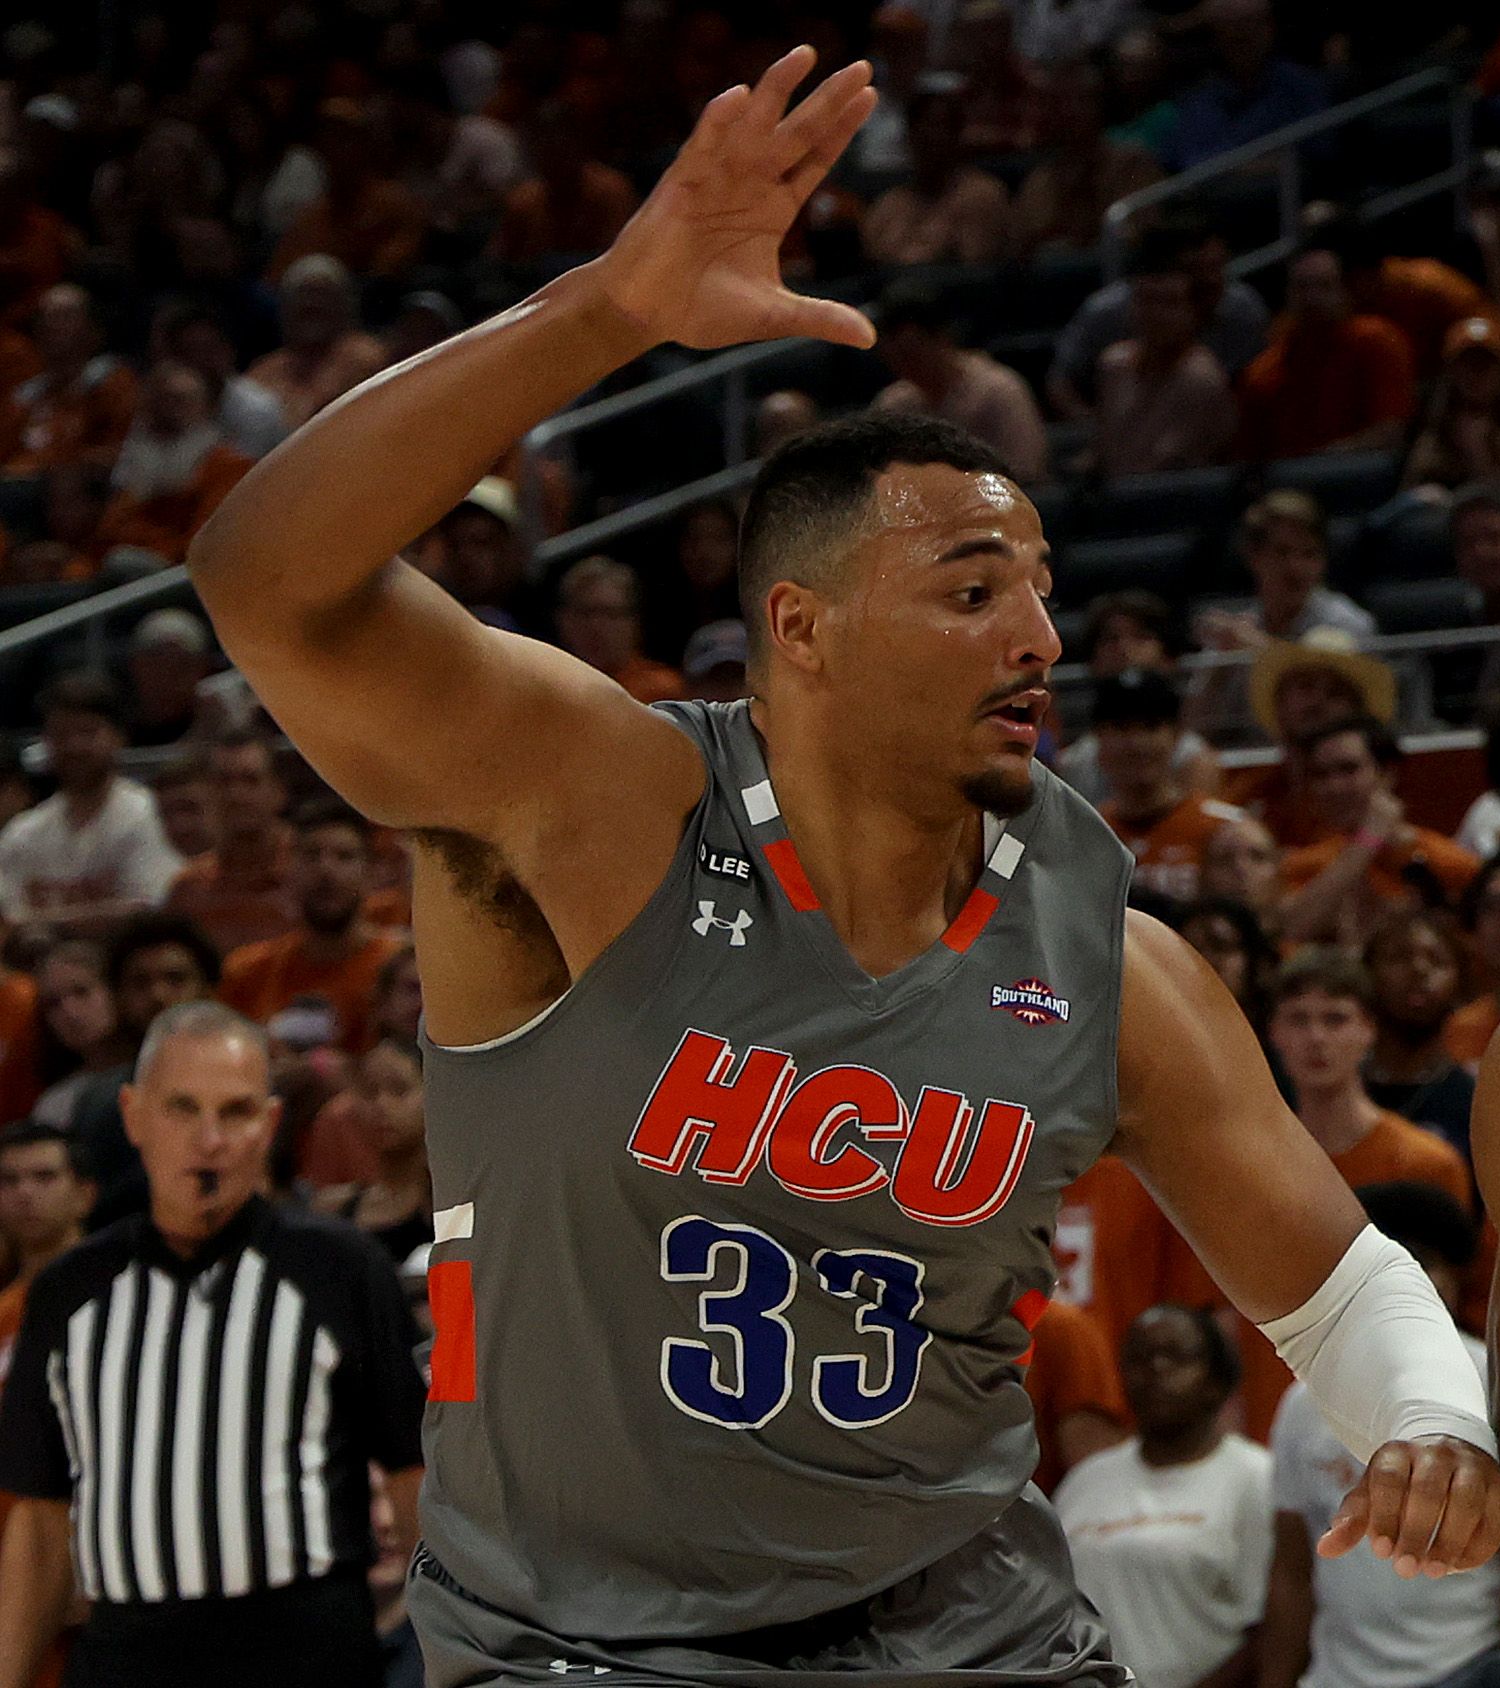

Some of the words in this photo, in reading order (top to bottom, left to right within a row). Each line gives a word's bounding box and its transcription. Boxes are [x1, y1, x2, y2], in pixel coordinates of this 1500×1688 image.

[708, 853, 751, 880] LEE
[991, 985, 1070, 1022] SOUTHLAND
[626, 1027, 1036, 1228] HCU
[659, 1213, 934, 1430] 33
